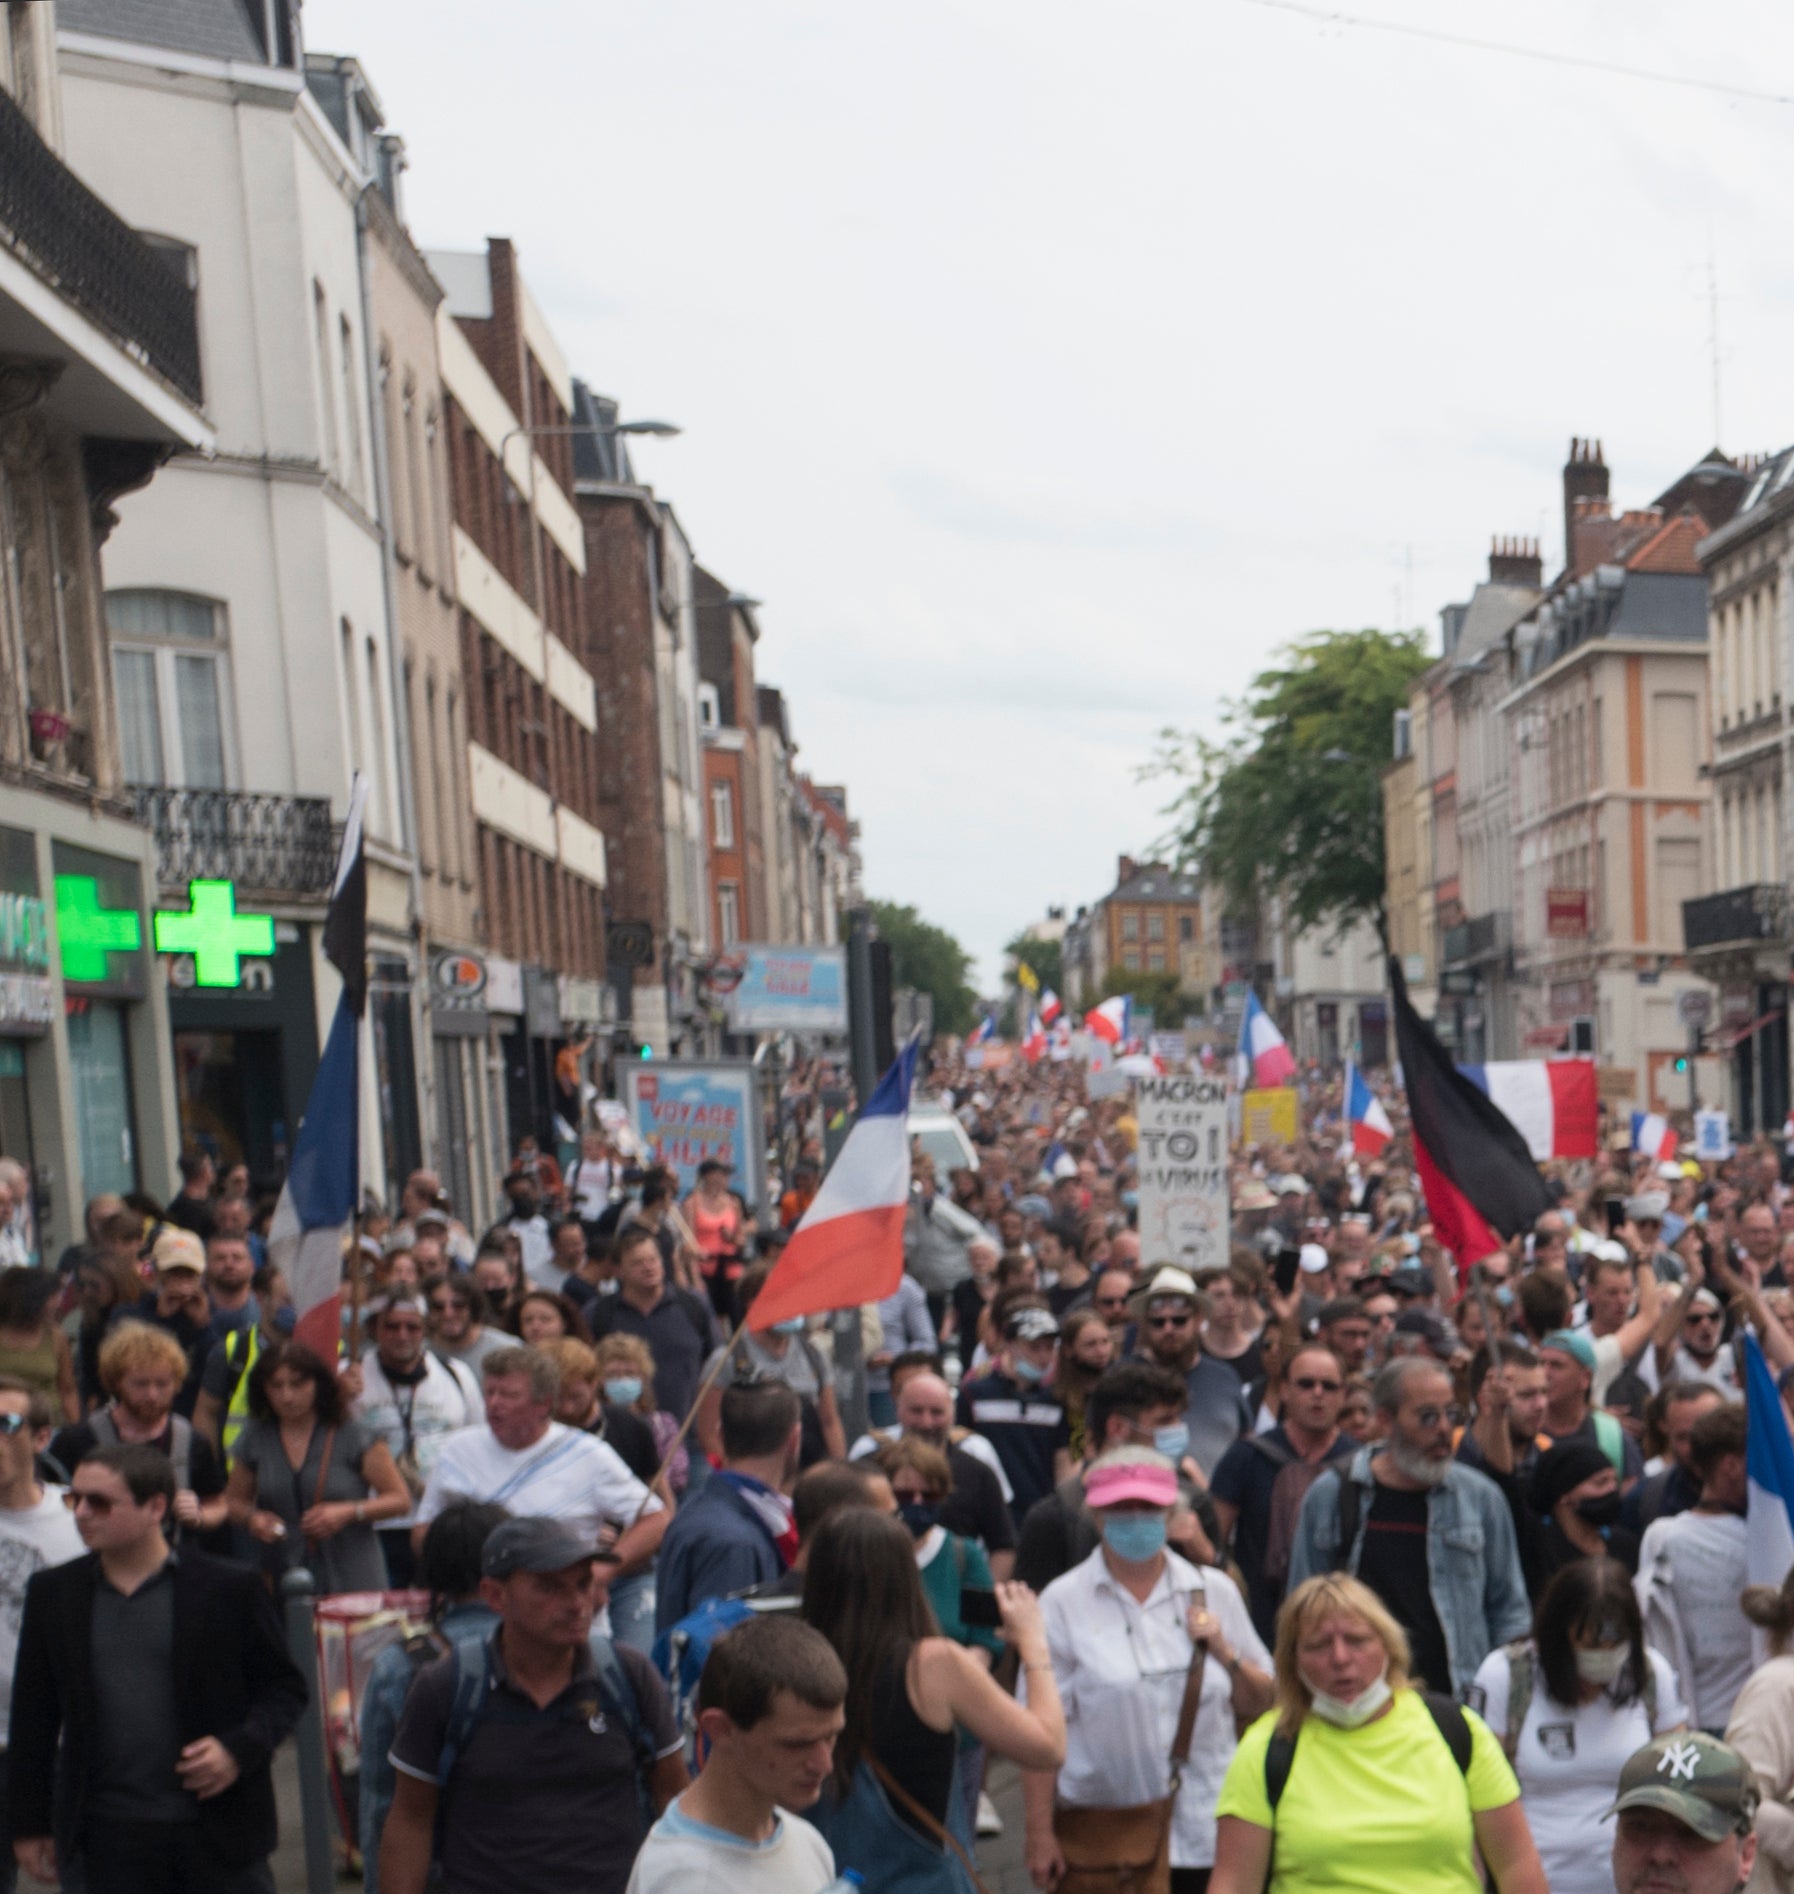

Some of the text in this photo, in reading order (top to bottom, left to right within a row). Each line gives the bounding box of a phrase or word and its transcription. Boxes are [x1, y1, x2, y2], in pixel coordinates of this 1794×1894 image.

[1139, 1080, 1227, 1104] MACRON
[651, 1101, 738, 1129] VOYAGE
[1656, 1741, 1702, 1781] NY
